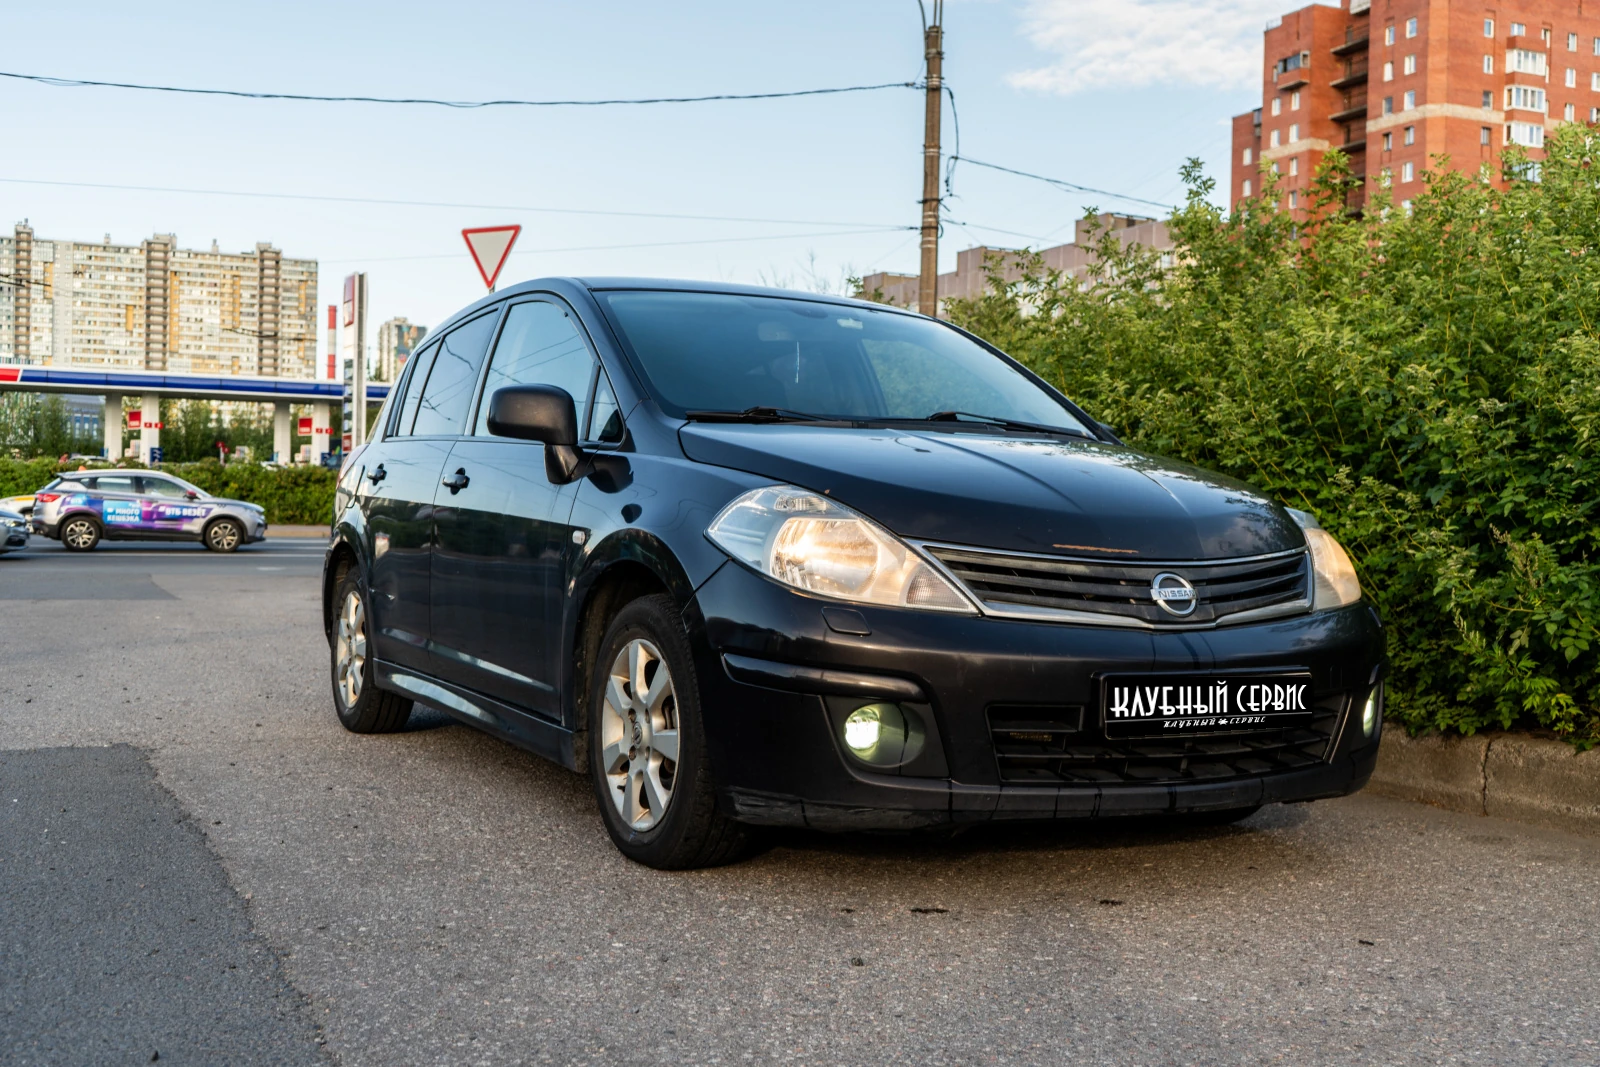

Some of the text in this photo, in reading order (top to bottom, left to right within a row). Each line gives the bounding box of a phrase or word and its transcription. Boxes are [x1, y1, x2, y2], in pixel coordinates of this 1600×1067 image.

[115, 507, 140, 515] МНОГО
[1158, 590, 1196, 598] NISSAN
[1110, 680, 1307, 718] КЛУБНЫЙ СЕРВИС
[1163, 716, 1266, 729] КЛУБНЫЙ СЕРВИС
